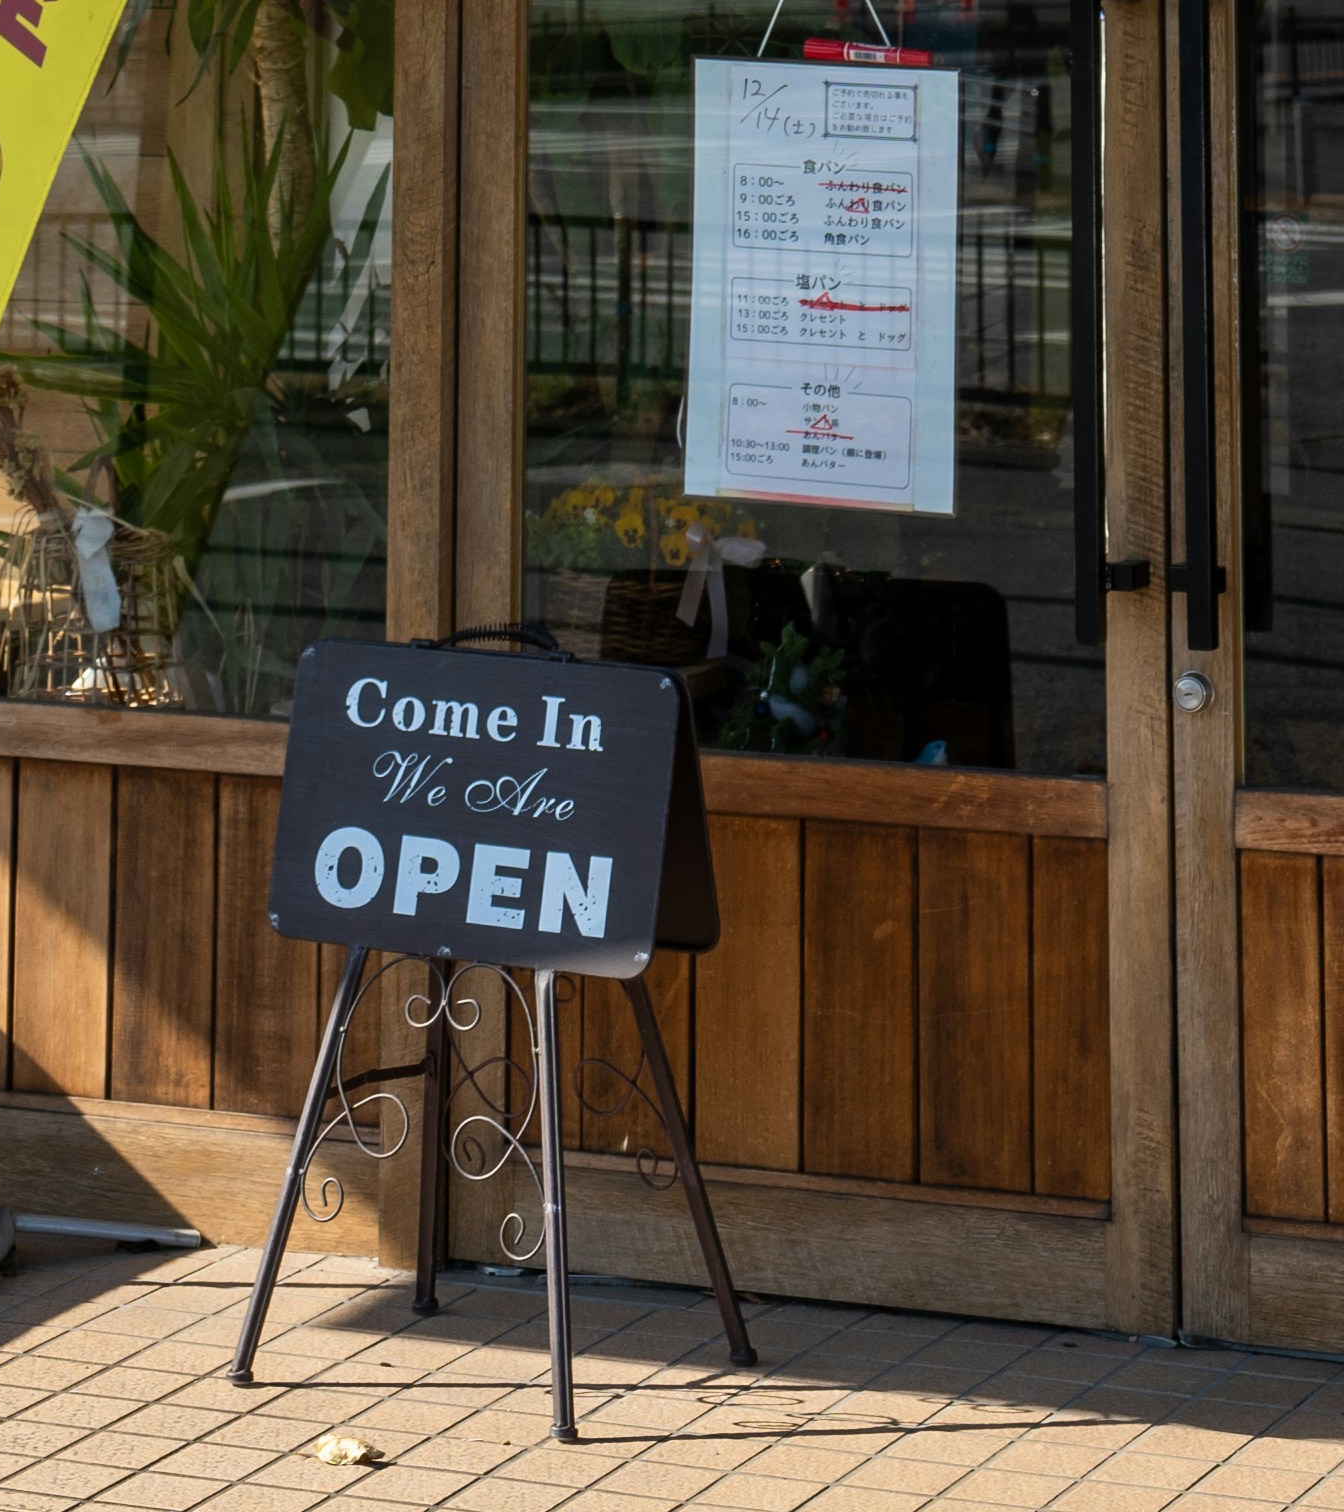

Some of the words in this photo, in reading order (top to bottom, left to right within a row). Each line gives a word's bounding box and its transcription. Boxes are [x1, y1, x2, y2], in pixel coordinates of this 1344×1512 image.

[803, 160, 846, 175] 食パン
[824, 215, 905, 230] ふんわり食パン
[824, 234, 870, 246] 角食パン
[796, 274, 841, 290] 塩パン
[799, 313, 846, 324] クレセント
[799, 328, 846, 339] クレセント
[859, 331, 866, 341] と
[879, 332, 907, 343] ドッグ
[800, 382, 841, 399] その他
[801, 458, 846, 469] あんバター
[345, 676, 518, 742] Come
[535, 695, 605, 753] In
[373, 750, 447, 808] We
[464, 769, 576, 822] Are
[313, 825, 614, 938] OPEN
